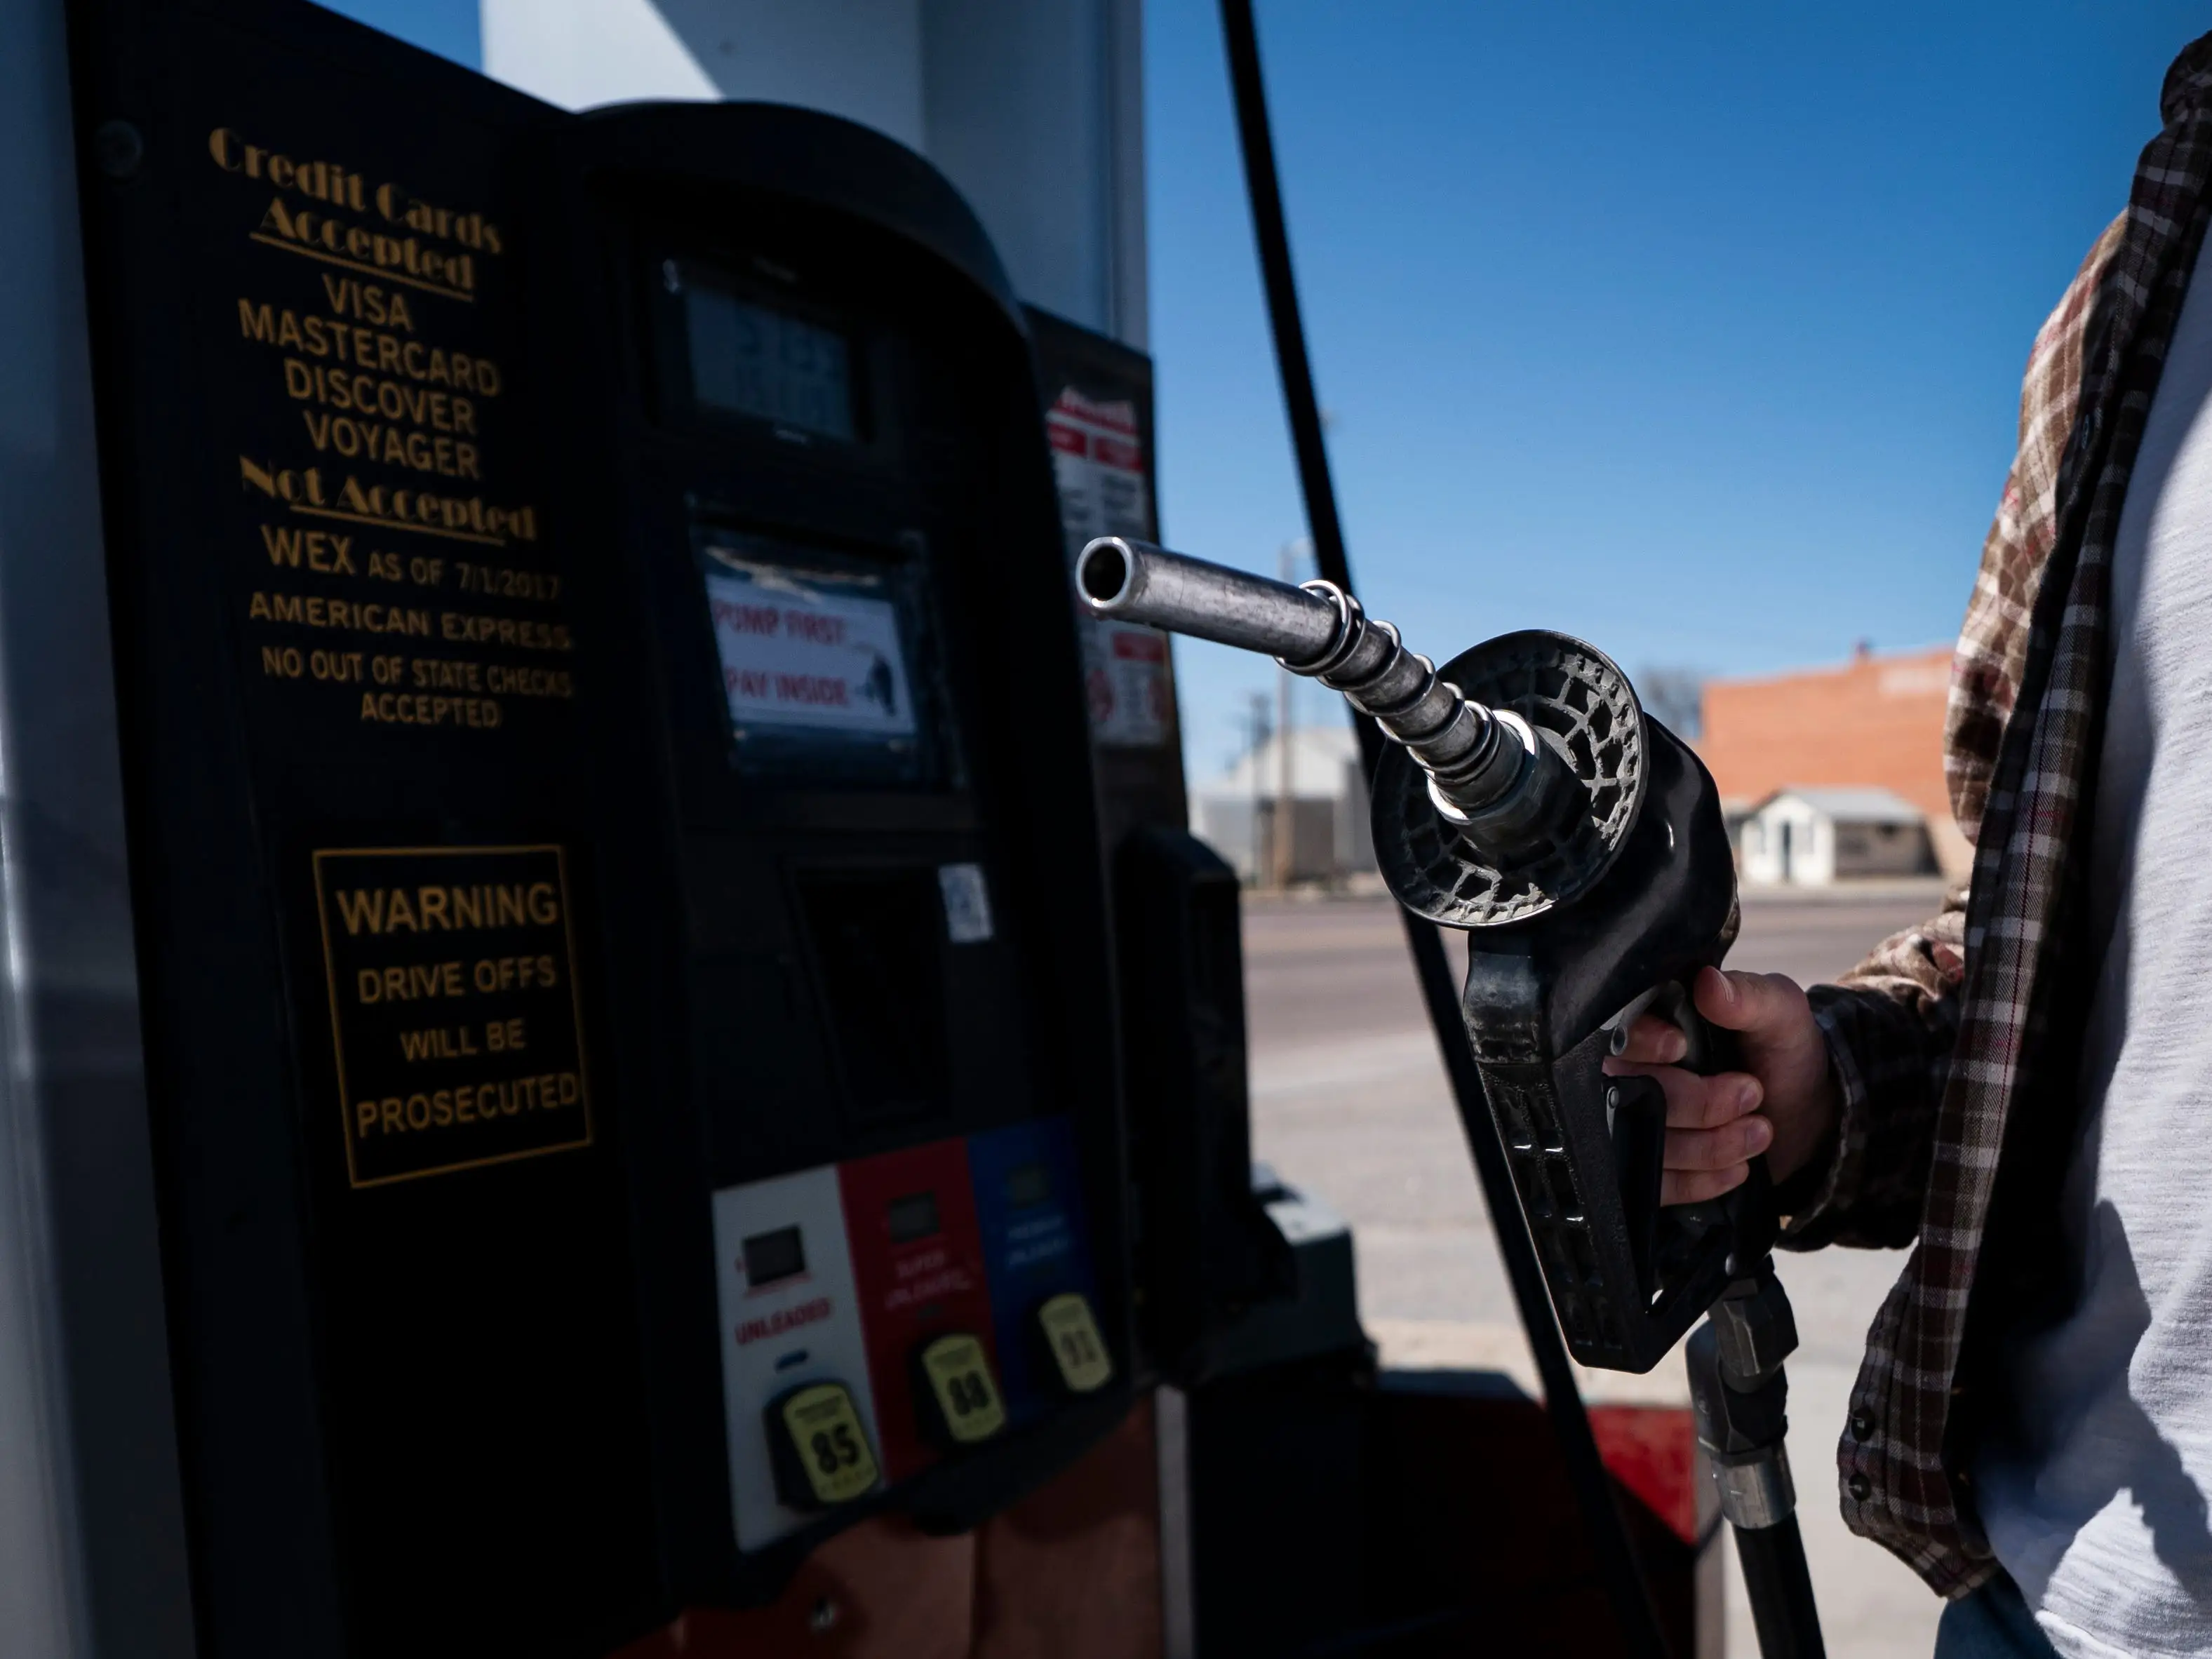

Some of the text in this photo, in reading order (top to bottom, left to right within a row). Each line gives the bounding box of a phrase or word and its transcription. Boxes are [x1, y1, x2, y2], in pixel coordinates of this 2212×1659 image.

[208, 126, 504, 255] Credit Cards
[259, 196, 476, 290] Accepted
[321, 272, 414, 333] VISA
[237, 296, 505, 398] MASTERCARD
[283, 356, 479, 436] DISCOVER
[302, 408, 485, 481] VOYAGER
[239, 454, 540, 542] Not Accepted
[260, 523, 563, 601] WEX AS OF 7/1/2017
[249, 591, 577, 652] AMERICAN EXPRESS
[710, 600, 779, 638] PUMP
[261, 645, 577, 700] NO OUT OF STATE CHECKS
[360, 690, 504, 730] ACCEPTED
[334, 882, 561, 936] WARNING
[356, 955, 559, 1005] DRIVE OFFS
[398, 1017, 528, 1063] WILL BE
[354, 1073, 582, 1139] PROSECUTED
[735, 1297, 832, 1345] UNLEADED
[811, 1422, 860, 1476] 85
